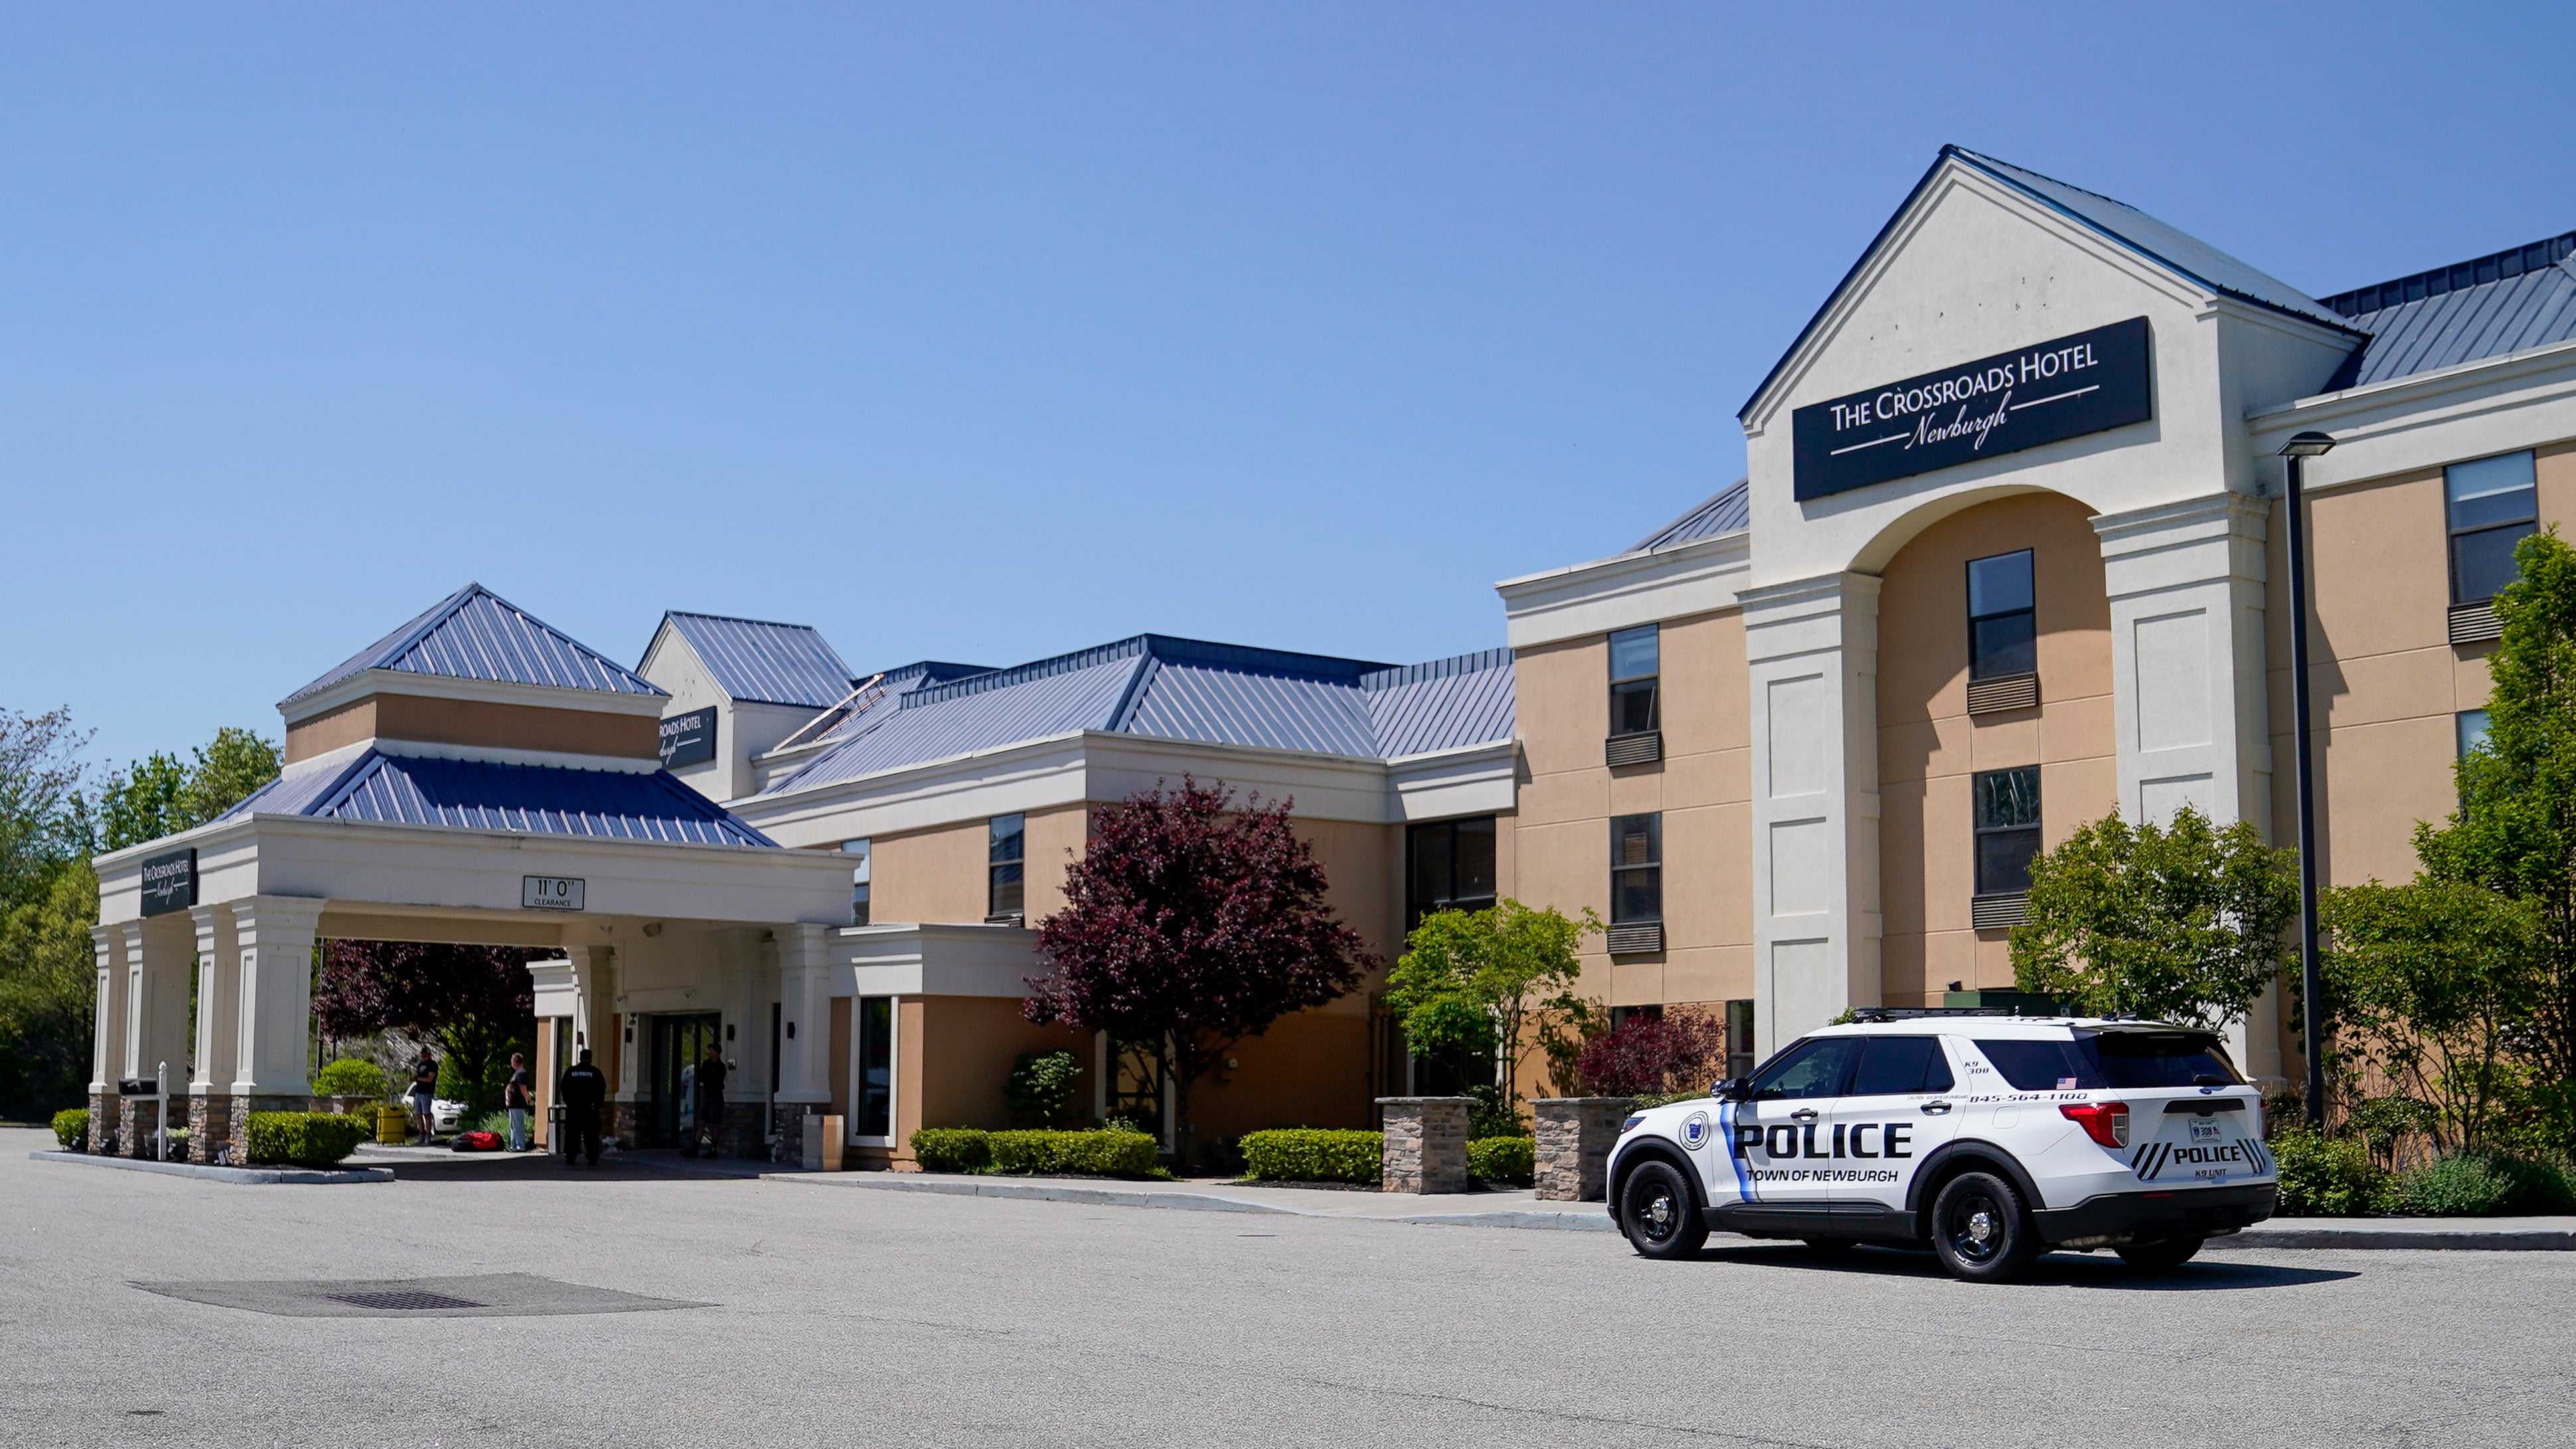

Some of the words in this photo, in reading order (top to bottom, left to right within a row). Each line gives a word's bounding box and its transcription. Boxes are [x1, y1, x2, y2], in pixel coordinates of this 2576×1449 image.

[1830, 403, 1871, 431] THE
[1875, 364, 2015, 421] CROSSROADS
[2021, 343, 2098, 383] HOTEL
[1904, 391, 2012, 450] Newburgh
[680, 715, 702, 733] HOTEL
[534, 898, 571, 907] CLEARANCE
[1969, 1093, 2088, 1103] 845-564-1100
[1733, 1123, 1914, 1159] POLICE
[2173, 1145, 2242, 1165] POLICE
[1746, 1170, 1789, 1181] TOWN
[1791, 1170, 1811, 1181] OF
[1812, 1170, 1898, 1182] NEWBURGH
[2209, 1168, 2227, 1177] UNIT
